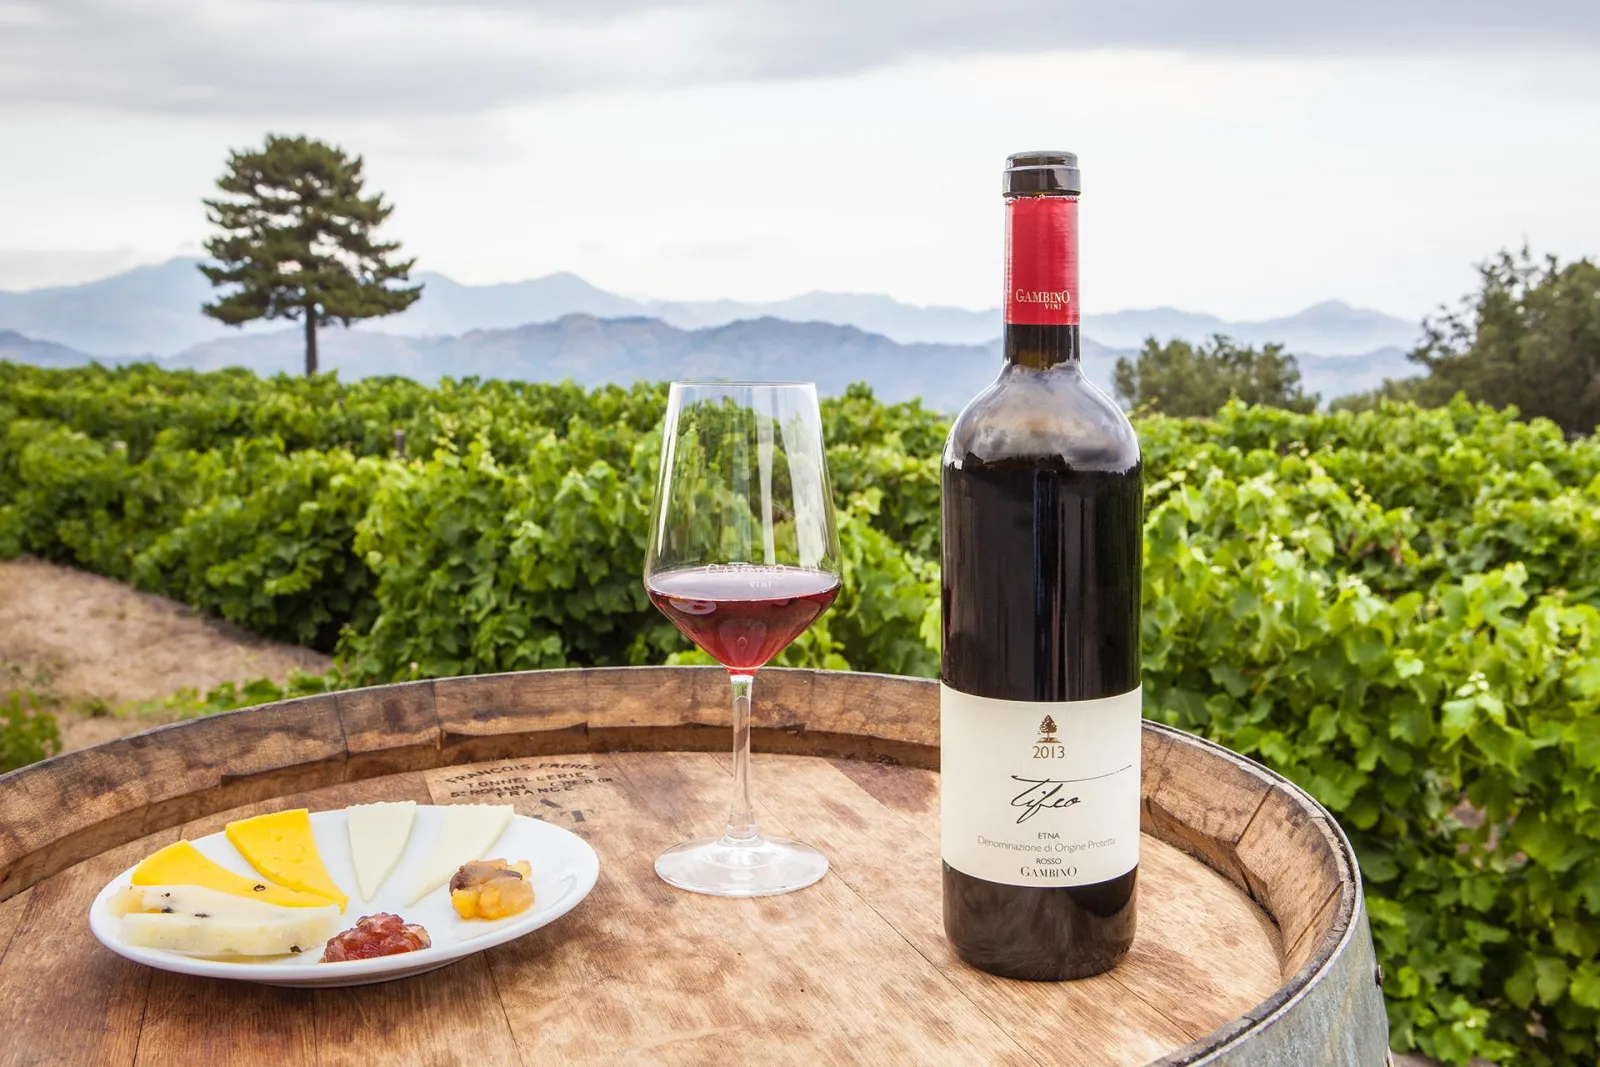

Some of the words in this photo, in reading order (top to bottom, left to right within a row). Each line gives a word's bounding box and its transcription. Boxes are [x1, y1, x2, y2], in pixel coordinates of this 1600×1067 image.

[1015, 288, 1071, 304] GAMBINO
[1032, 745, 1066, 759] 2013
[1037, 832, 1061, 840] ETNA
[977, 835, 1042, 853] Denominazione
[1044, 842, 1052, 852] di
[1054, 842, 1086, 854] Origine
[1087, 837, 1116, 850] Protetta
[1035, 857, 1062, 865] ROSSO
[1020, 866, 1078, 878] GAMBINO
